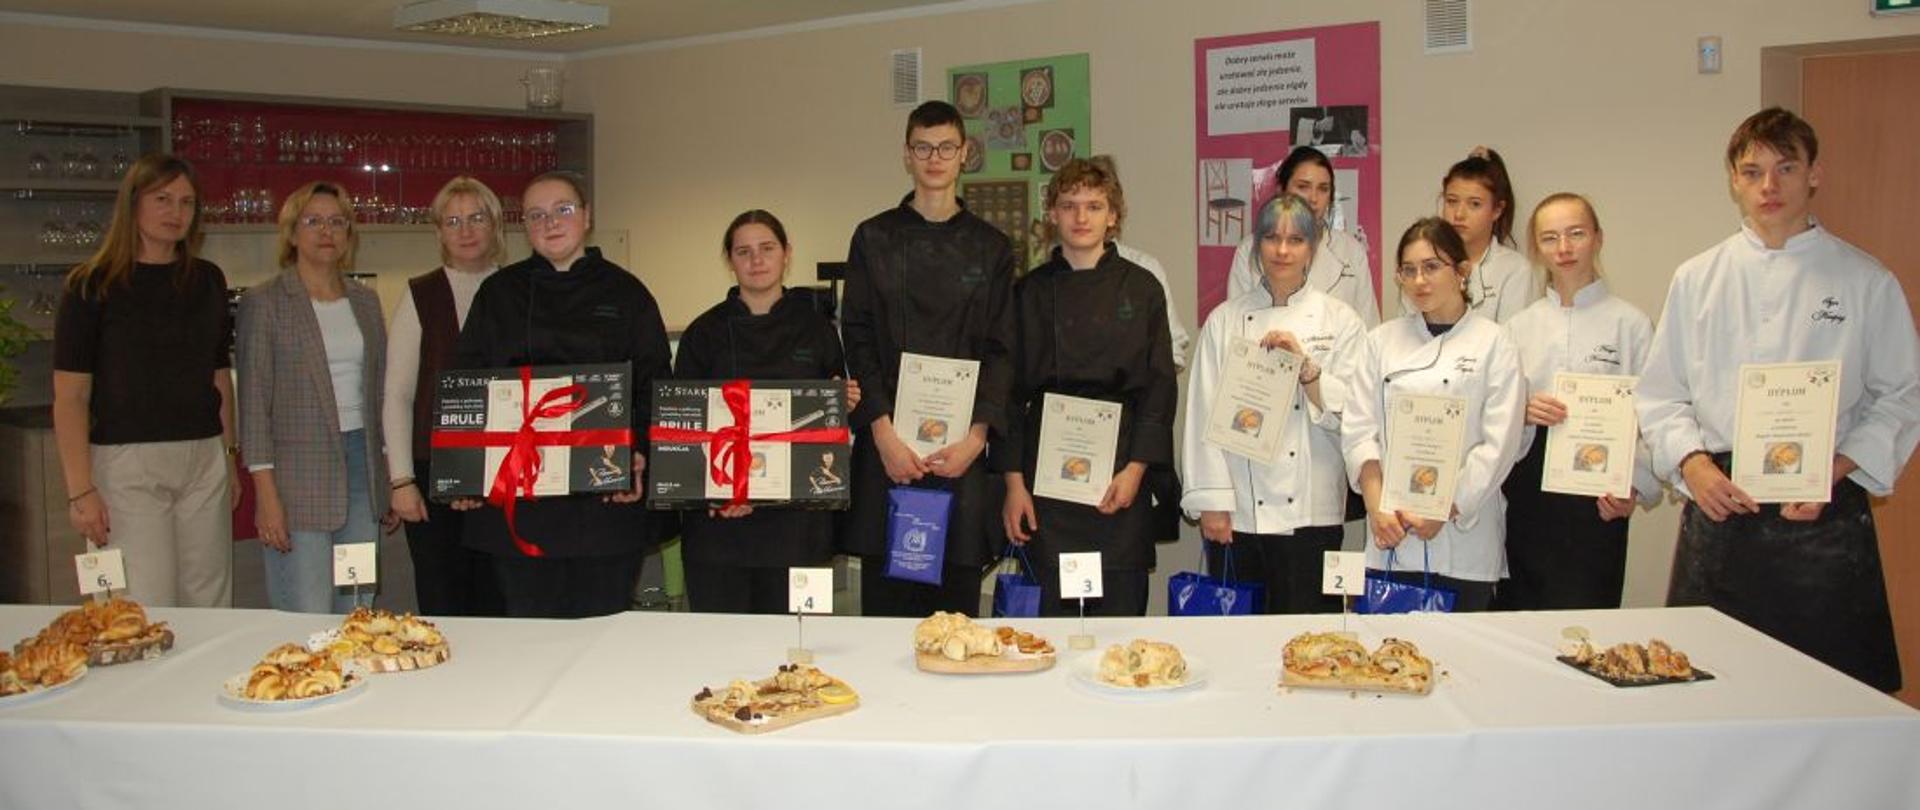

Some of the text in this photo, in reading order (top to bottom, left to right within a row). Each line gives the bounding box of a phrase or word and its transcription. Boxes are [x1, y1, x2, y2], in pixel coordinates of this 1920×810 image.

[1224, 56, 1248, 66] Dobry
[1274, 51, 1296, 61] może
[1217, 80, 1308, 96] ale dobre jedzenie nigdy
[1214, 101, 1226, 110] nie
[441, 413, 485, 426] BRULE
[348, 566, 357, 580] 5
[1082, 578, 1093, 593] 3
[1334, 575, 1344, 589] 2
[804, 596, 814, 610] 4
